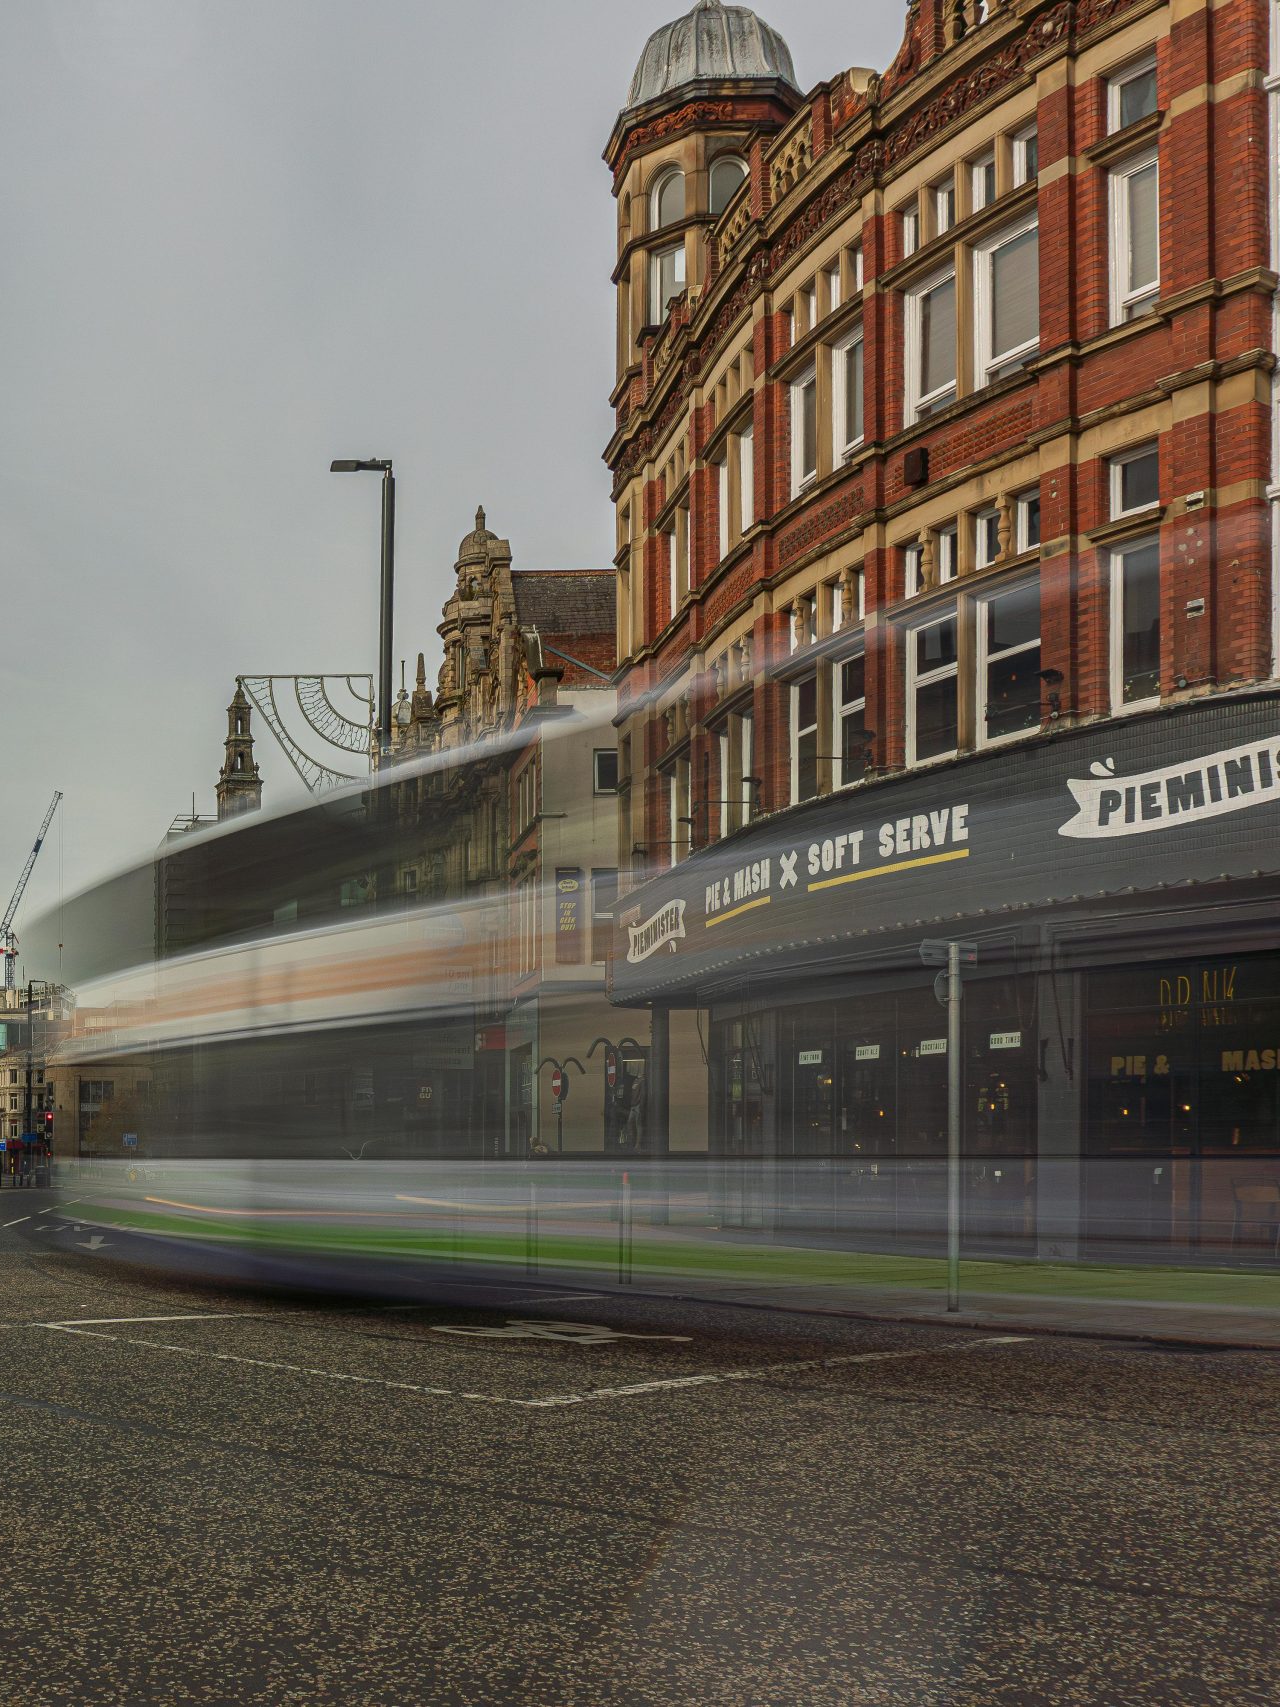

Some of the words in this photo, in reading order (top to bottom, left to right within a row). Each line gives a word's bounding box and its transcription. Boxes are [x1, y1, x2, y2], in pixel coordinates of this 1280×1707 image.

[1098, 748, 1280, 826] PIEMINI
[705, 882, 721, 915] PIE
[722, 877, 731, 906] &
[733, 858, 771, 902] MASH
[808, 830, 864, 876] SOFT
[878, 803, 969, 857] SERVE
[633, 906, 680, 957] PIEMINISTER
[1110, 1055, 1147, 1076] PIE
[1153, 1054, 1170, 1075] &
[1221, 1048, 1280, 1072] MAS
